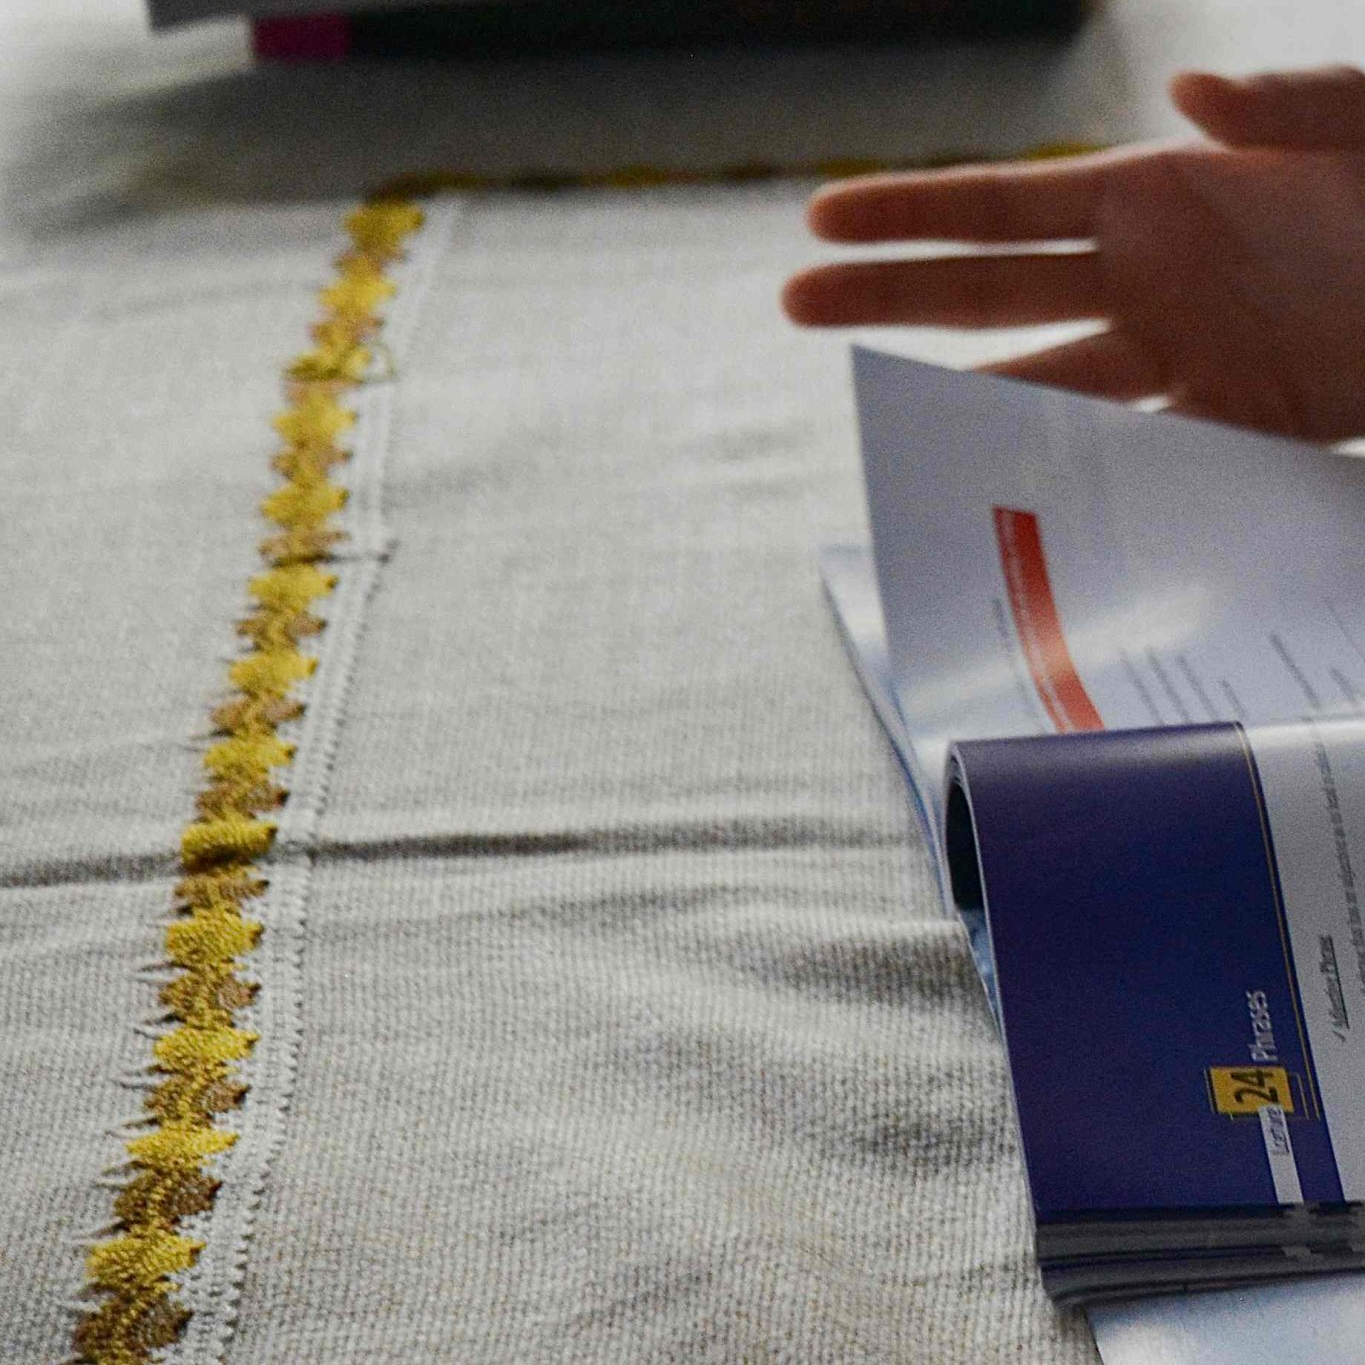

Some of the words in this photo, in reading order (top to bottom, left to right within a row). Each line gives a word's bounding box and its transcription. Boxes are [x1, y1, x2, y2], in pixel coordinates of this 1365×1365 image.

[1330, 839, 1359, 887] adjective
[1312, 936, 1336, 973] Phrase
[1320, 974, 1349, 1028] Adjective
[1246, 989, 1279, 1062] Phrases
[1230, 1068, 1280, 1105] 24
[1266, 1107, 1291, 1156] Lecture
